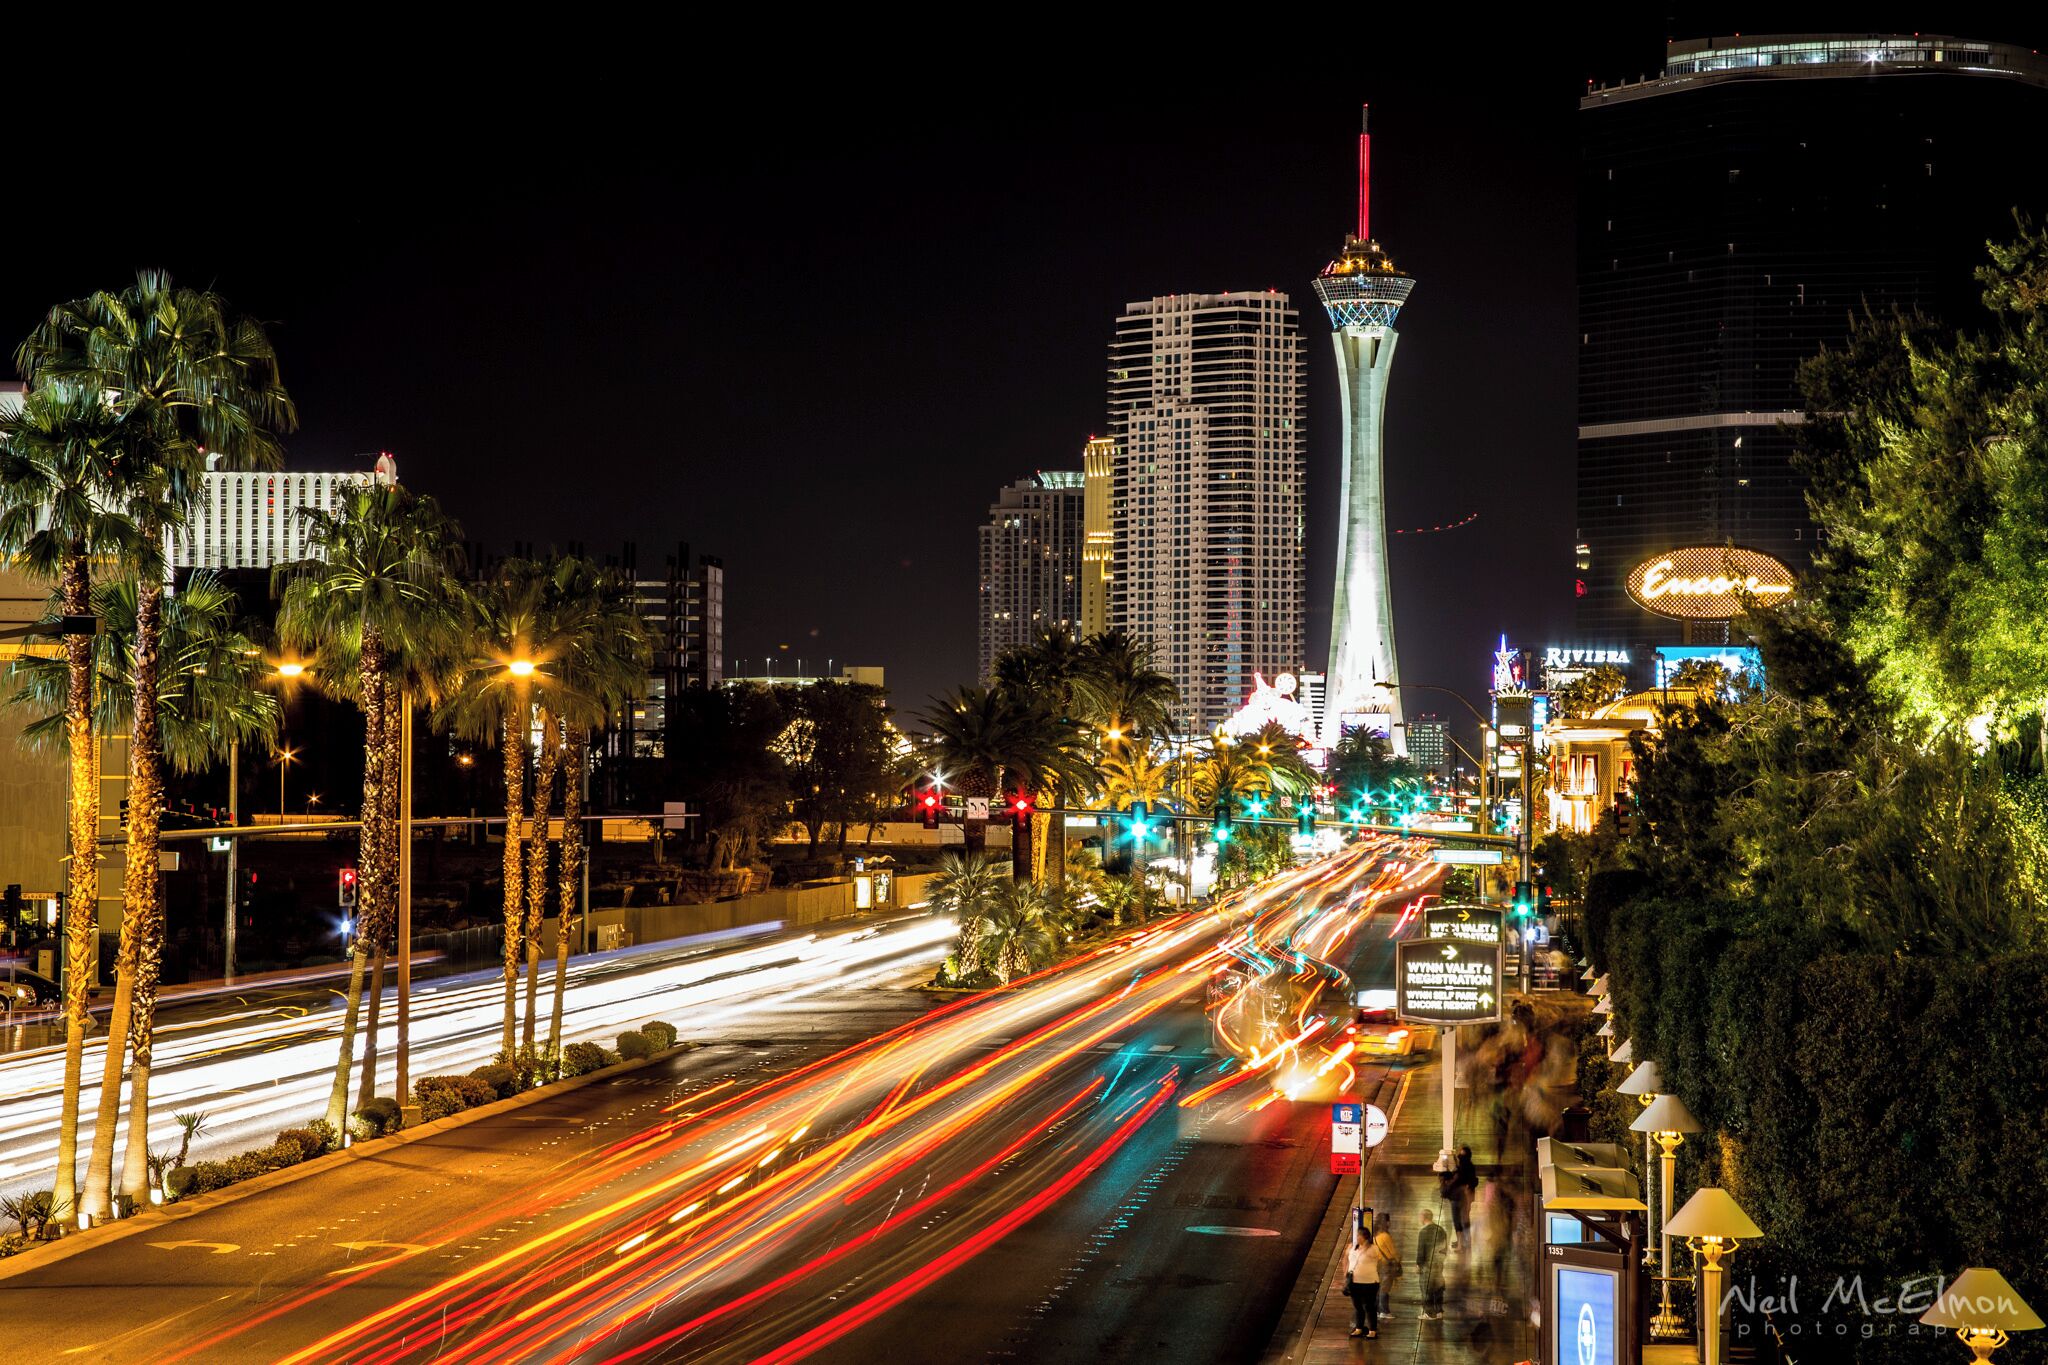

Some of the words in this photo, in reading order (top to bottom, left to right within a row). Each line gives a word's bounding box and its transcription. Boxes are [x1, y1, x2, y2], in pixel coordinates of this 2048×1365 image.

[1545, 648, 1630, 668] RIVIERA
[1407, 962, 1443, 973] WYNN
[1445, 963, 1483, 974] VALET
[1484, 965, 1492, 974] &
[1407, 973, 1492, 985] REGISTRATION
[1406, 990, 1432, 999] WYNN
[1548, 1246, 1564, 1256] 1353
